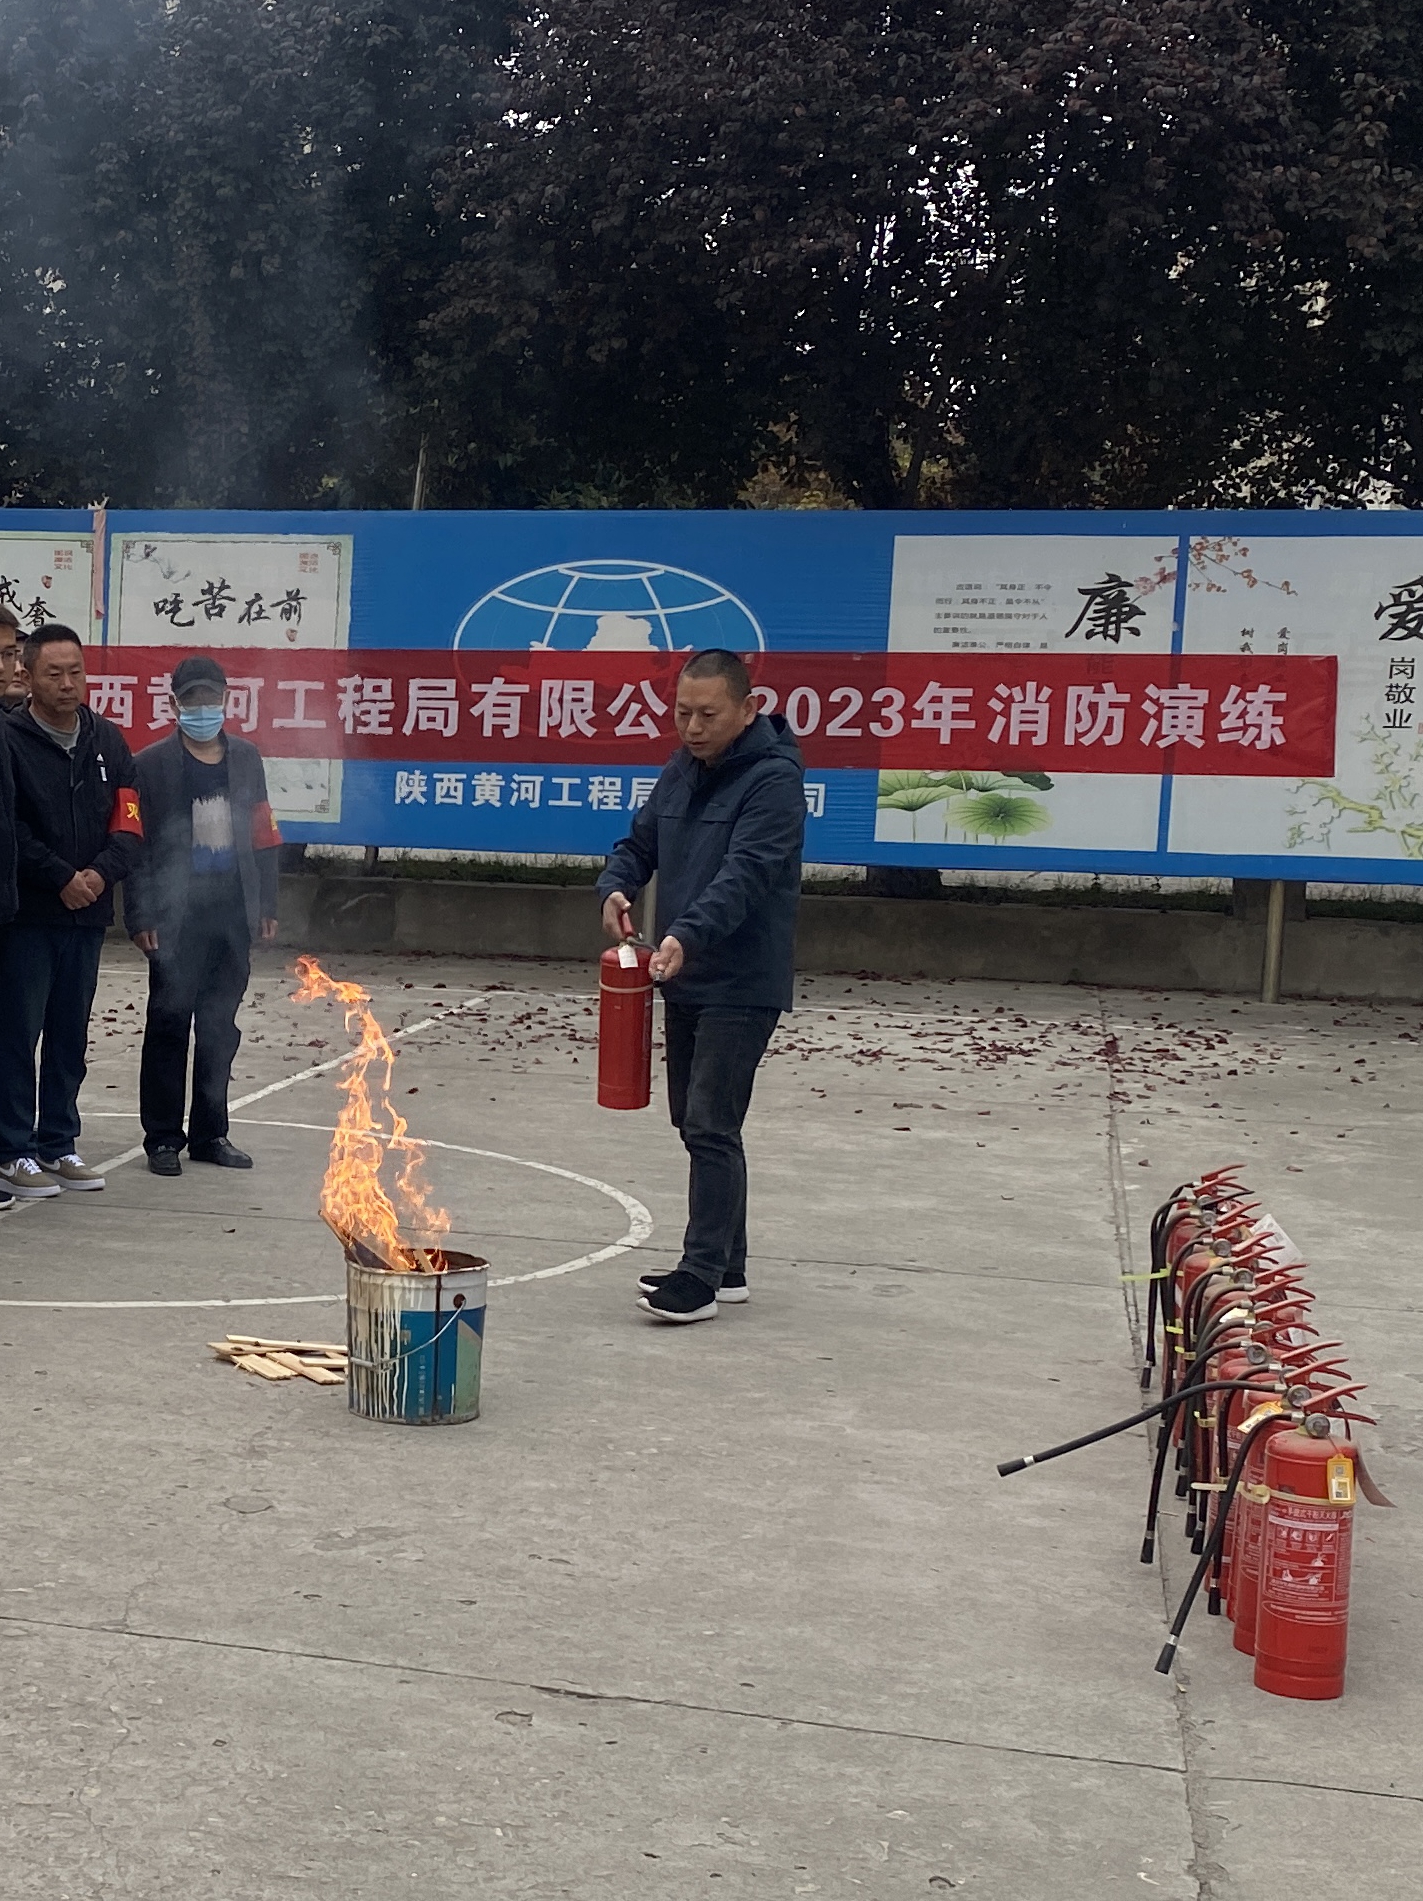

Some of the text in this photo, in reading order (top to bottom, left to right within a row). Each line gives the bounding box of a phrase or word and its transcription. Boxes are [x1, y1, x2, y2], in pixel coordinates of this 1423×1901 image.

[153, 576, 308, 627] 吃苦在前
[1065, 572, 1147, 644] 廉
[1382, 656, 1416, 729] 岗敬业
